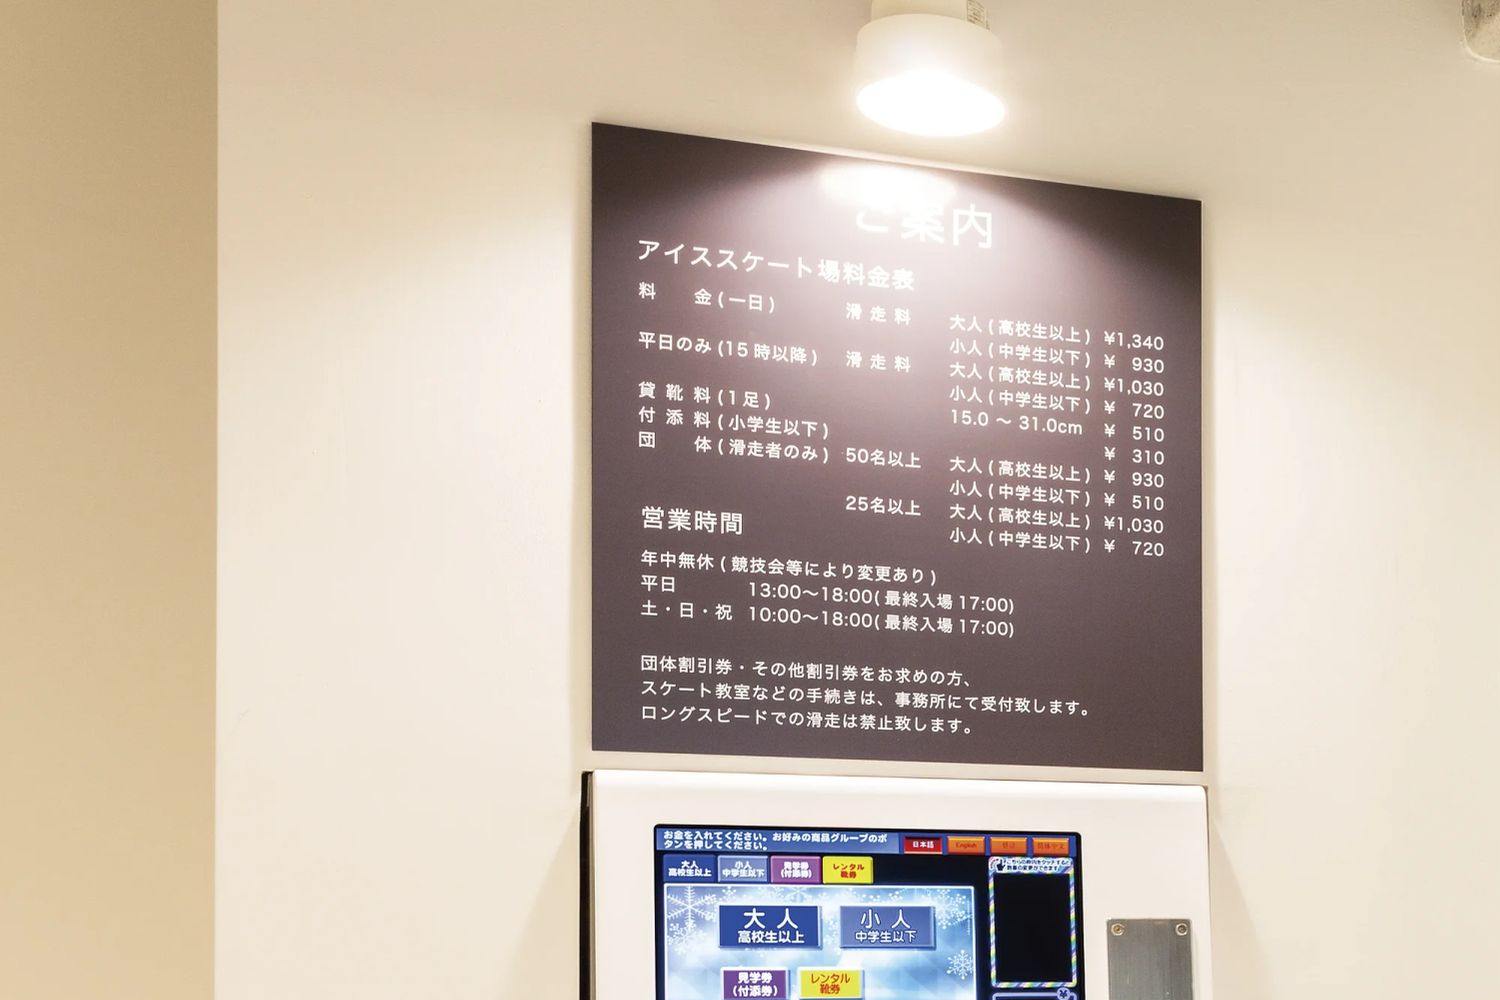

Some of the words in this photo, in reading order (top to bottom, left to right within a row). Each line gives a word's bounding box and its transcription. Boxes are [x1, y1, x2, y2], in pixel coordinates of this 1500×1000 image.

[638, 240, 915, 291] アイススケート場料金表
[846, 303, 910, 325] 滑走料
[950, 315, 1090, 345] 大人(高校生以上)
[1105, 331, 1164, 350] ¥1,340
[950, 339, 1090, 368] 小人(中学生以下)
[1133, 357, 1164, 373] 930
[846, 351, 911, 372] 滑走料
[950, 362, 1090, 391] 大人(高校生以上)
[1105, 378, 1163, 396] ¥1,030
[950, 386, 1090, 414] 小人(中学生以下)
[1133, 403, 1164, 419] 720
[1133, 426, 1164, 442] 510
[847, 448, 921, 468] 50名以上
[950, 456, 1090, 484] 大人(高校生以上)
[1133, 472, 1164, 487] 930
[1133, 449, 1164, 465] 310
[950, 480, 1090, 507] 小人(中学生以下)
[1133, 495, 1164, 510] 510
[642, 506, 742, 534] 営業時間
[846, 496, 921, 515] 25名以上
[950, 504, 1090, 530] 大人(高校生以上)
[1105, 516, 1163, 533] ¥1,030
[950, 527, 1090, 553] 小人(中学生以下)
[1133, 541, 1164, 556] 720
[641, 575, 674, 592] 平日
[641, 655, 969, 686] 団体割引券・その他割引券をお求めの方、
[642, 681, 1087, 716] スケート教室などの手続きは、事務所にて受付致します。
[643, 706, 970, 734] ロングスピードでの滑走は禁止致します。
[743, 907, 798, 930] 大人
[861, 909, 910, 929] 小人
[738, 930, 805, 944] 高校生以上
[855, 930, 917, 944] 中学生以下
[811, 973, 850, 984] レンタル
